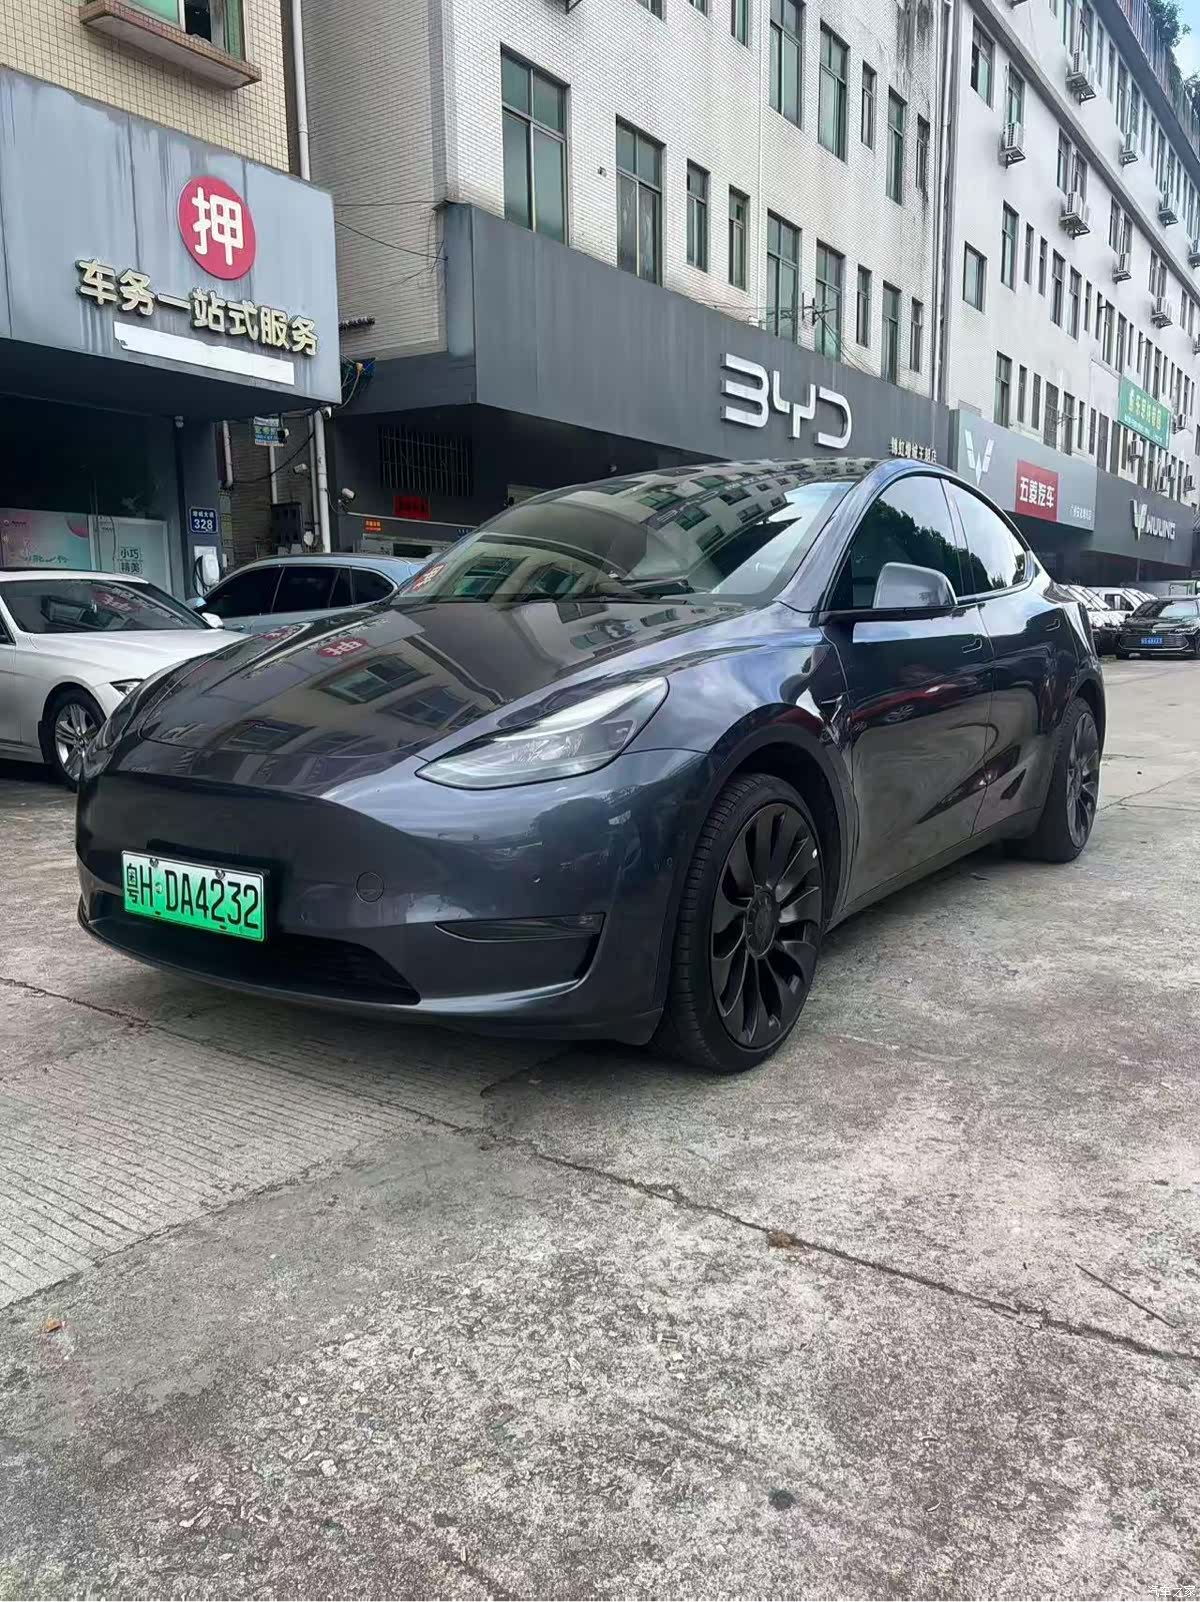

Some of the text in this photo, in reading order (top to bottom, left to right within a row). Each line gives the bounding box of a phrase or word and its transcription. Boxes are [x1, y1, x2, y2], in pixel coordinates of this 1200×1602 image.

[192, 186, 244, 266] 押
[75, 258, 319, 356] 车务一站式服务
[721, 352, 852, 449] BYD
[1020, 476, 1055, 508] 五菱汽车
[194, 518, 213, 530] 328
[1146, 515, 1176, 540] WULING
[120, 548, 139, 559] 小巧
